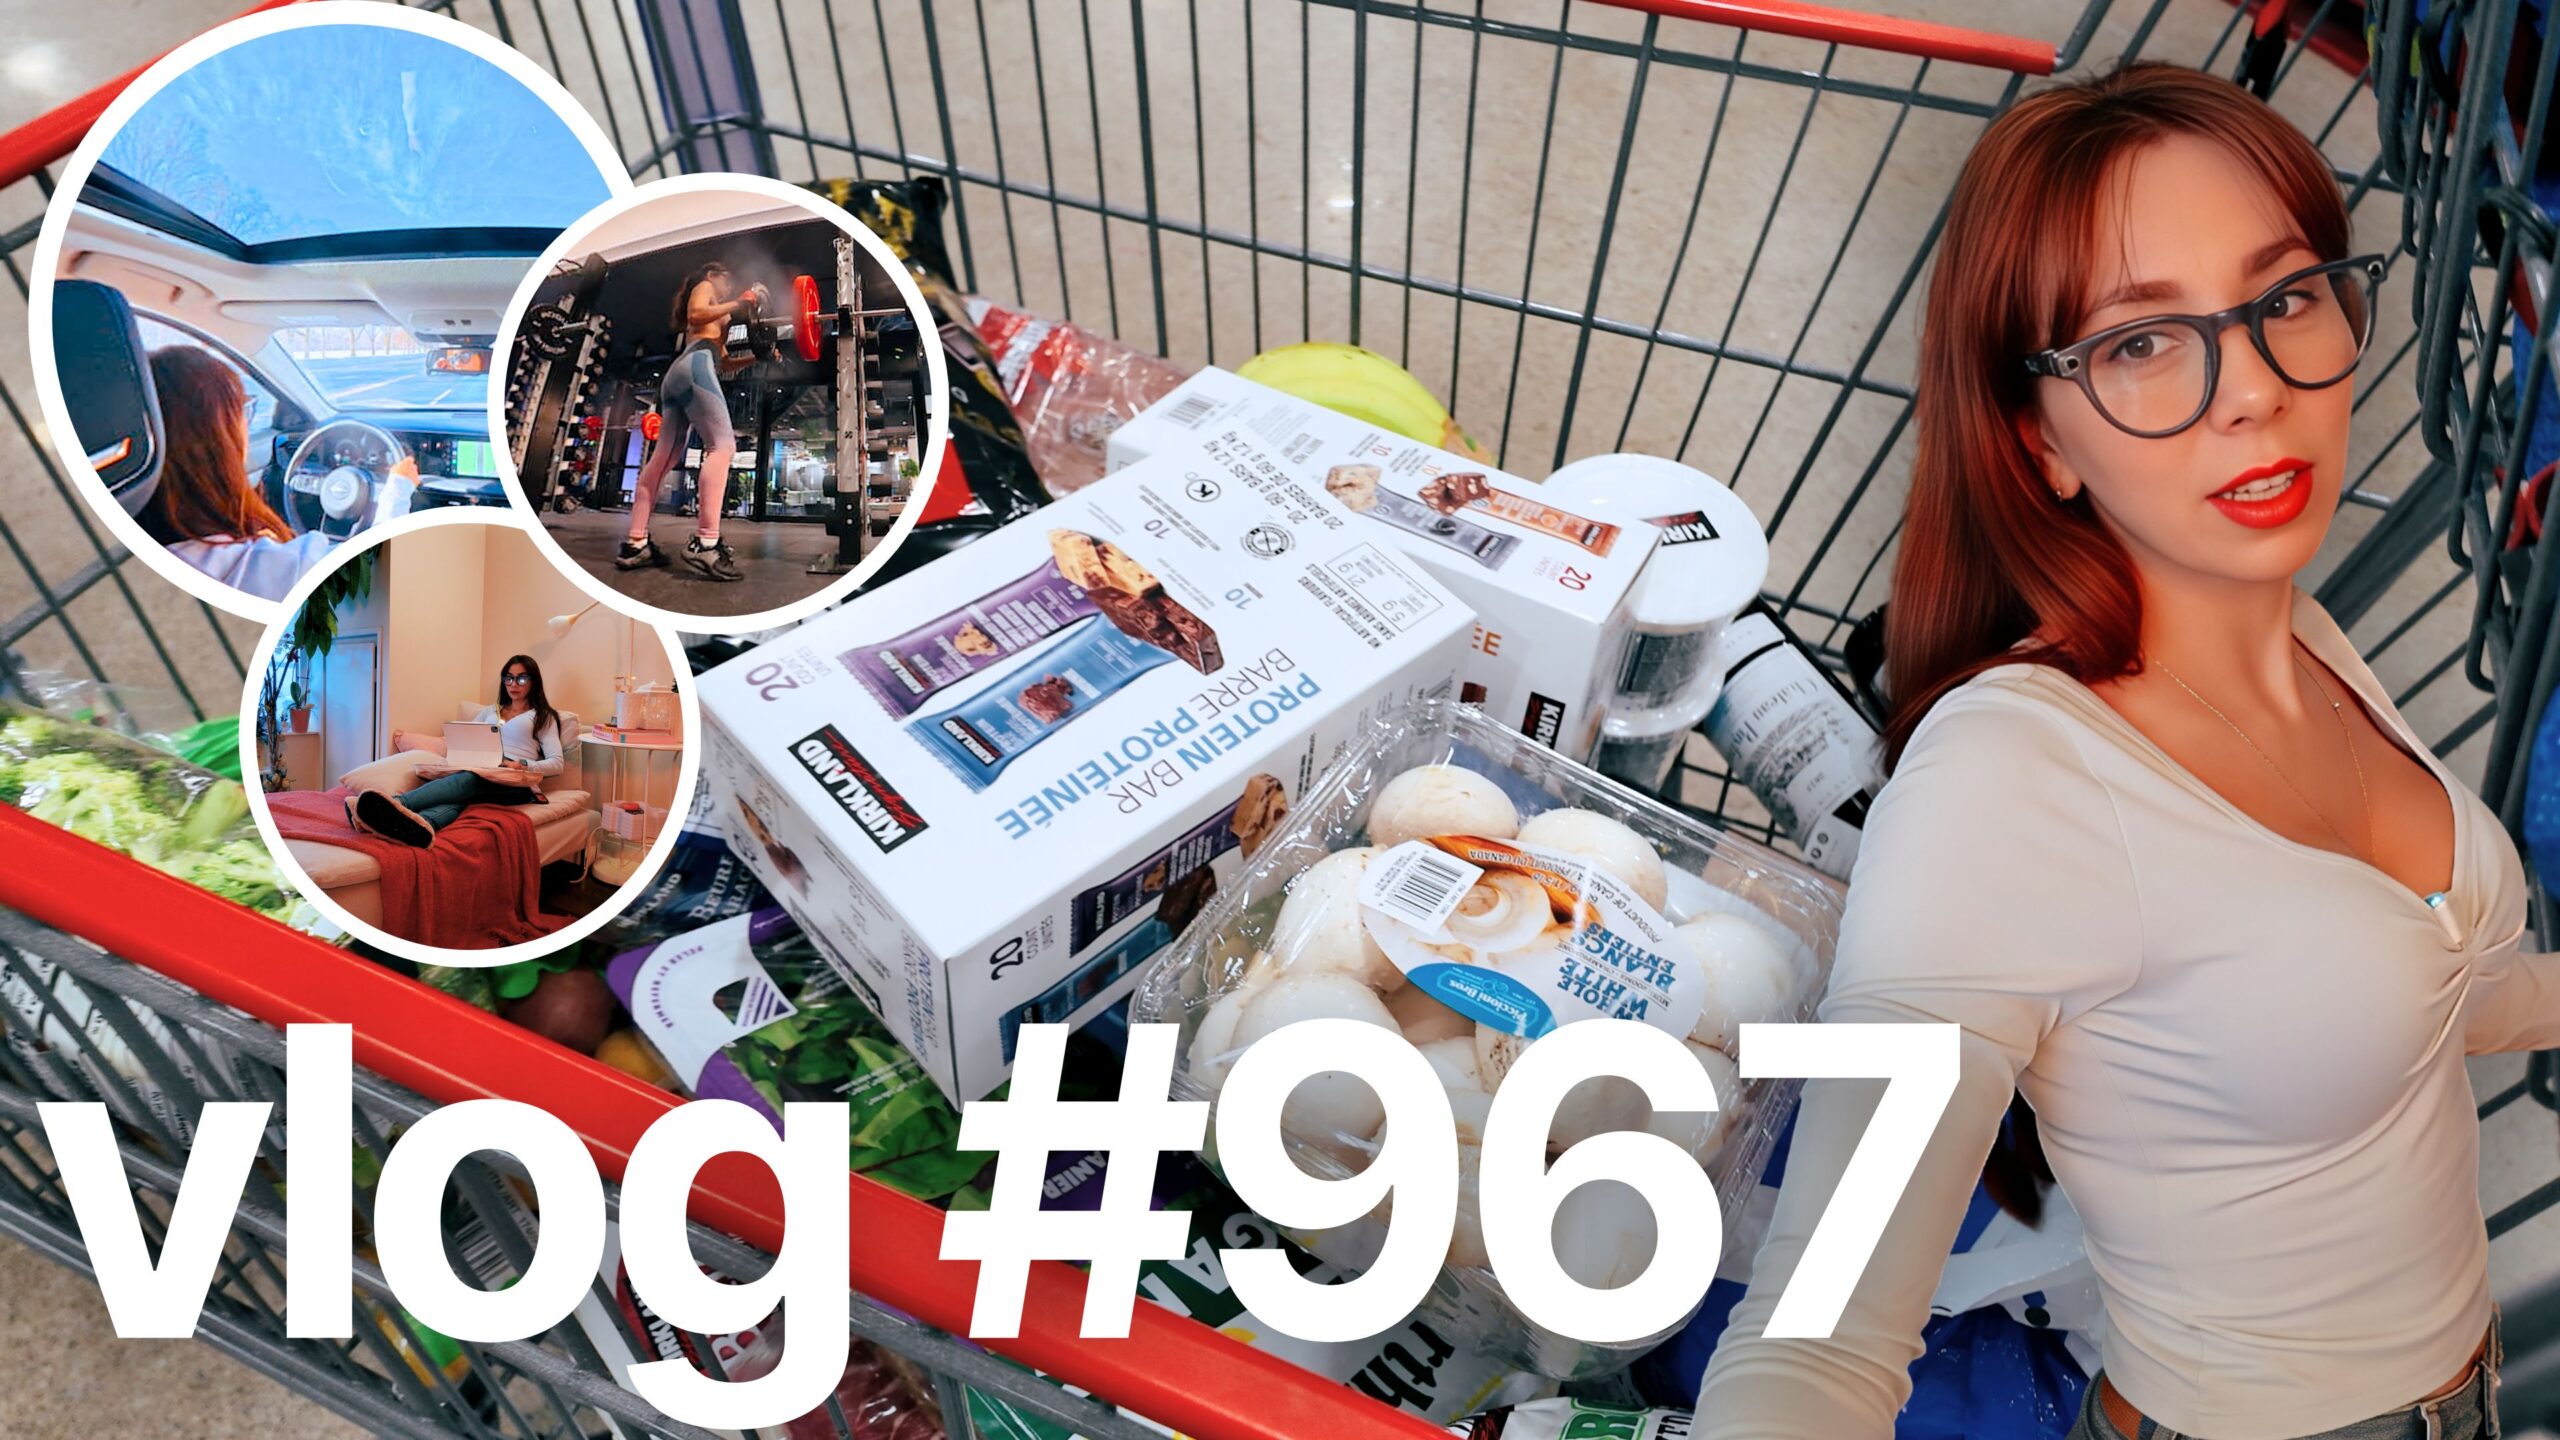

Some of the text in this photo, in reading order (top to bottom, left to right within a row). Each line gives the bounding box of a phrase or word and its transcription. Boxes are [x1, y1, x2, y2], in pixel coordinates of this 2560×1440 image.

[1202, 438, 1220, 456] kg
[1219, 429, 1238, 446] kg
[1228, 461, 1264, 490] BARS
[1254, 459, 1277, 475] 60
[1268, 471, 1290, 487] DE
[1263, 490, 1287, 508] 60
[1282, 482, 1330, 520] BARRES
[1141, 518, 1171, 540] 10
[1286, 508, 1308, 526] 20
[1322, 514, 1344, 531] 20
[1296, 575, 1336, 608] FLAVOURS
[1303, 562, 1348, 599] ARTIFICIELS
[1557, 565, 1591, 591] 20
[1223, 585, 1252, 612] 10
[1330, 604, 1371, 639] ARTIFICIAL
[1371, 620, 1396, 641] SANS
[1390, 610, 1406, 622] 5
[1366, 636, 1383, 649] NO
[742, 663, 800, 705] 20
[778, 652, 817, 687] COUNT
[877, 649, 926, 693] KIRKLAND
[940, 718, 996, 764] KIRKLAND
[993, 644, 1295, 844] BARRE PROTÉINÉE
[1106, 670, 1322, 817] PROTEIN BAR
[794, 735, 907, 844] KIRKLAND
[1468, 848, 1514, 860] CANADA
[1575, 871, 1615, 900] CANAA
[1610, 897, 1627, 910] OF
[1622, 907, 1662, 944] PRODUCT
[988, 936, 1023, 980] 20
[1569, 927, 1676, 993] BLANCS
[1586, 920, 1676, 974] ENTIERS
[1558, 955, 1649, 1020] WHITE
[1476, 991, 1527, 1022] Piccioni
